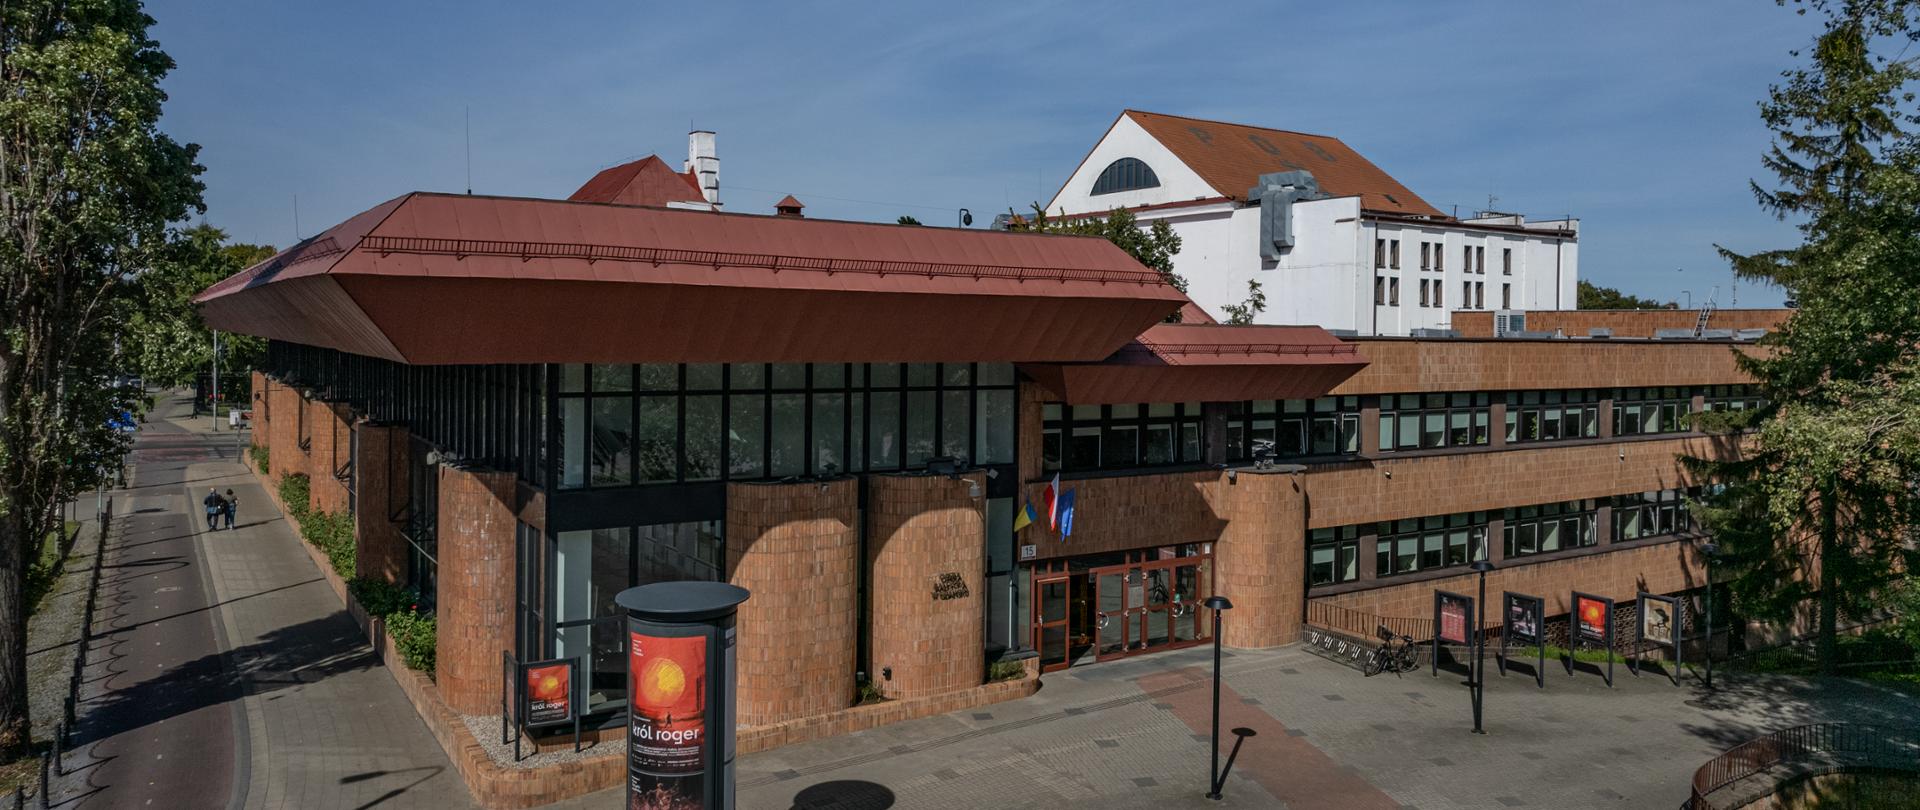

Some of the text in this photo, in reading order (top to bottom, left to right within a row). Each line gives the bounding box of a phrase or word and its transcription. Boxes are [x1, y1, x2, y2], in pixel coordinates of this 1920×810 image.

[1026, 546, 1034, 556] 15
[633, 720, 700, 745] król roger
